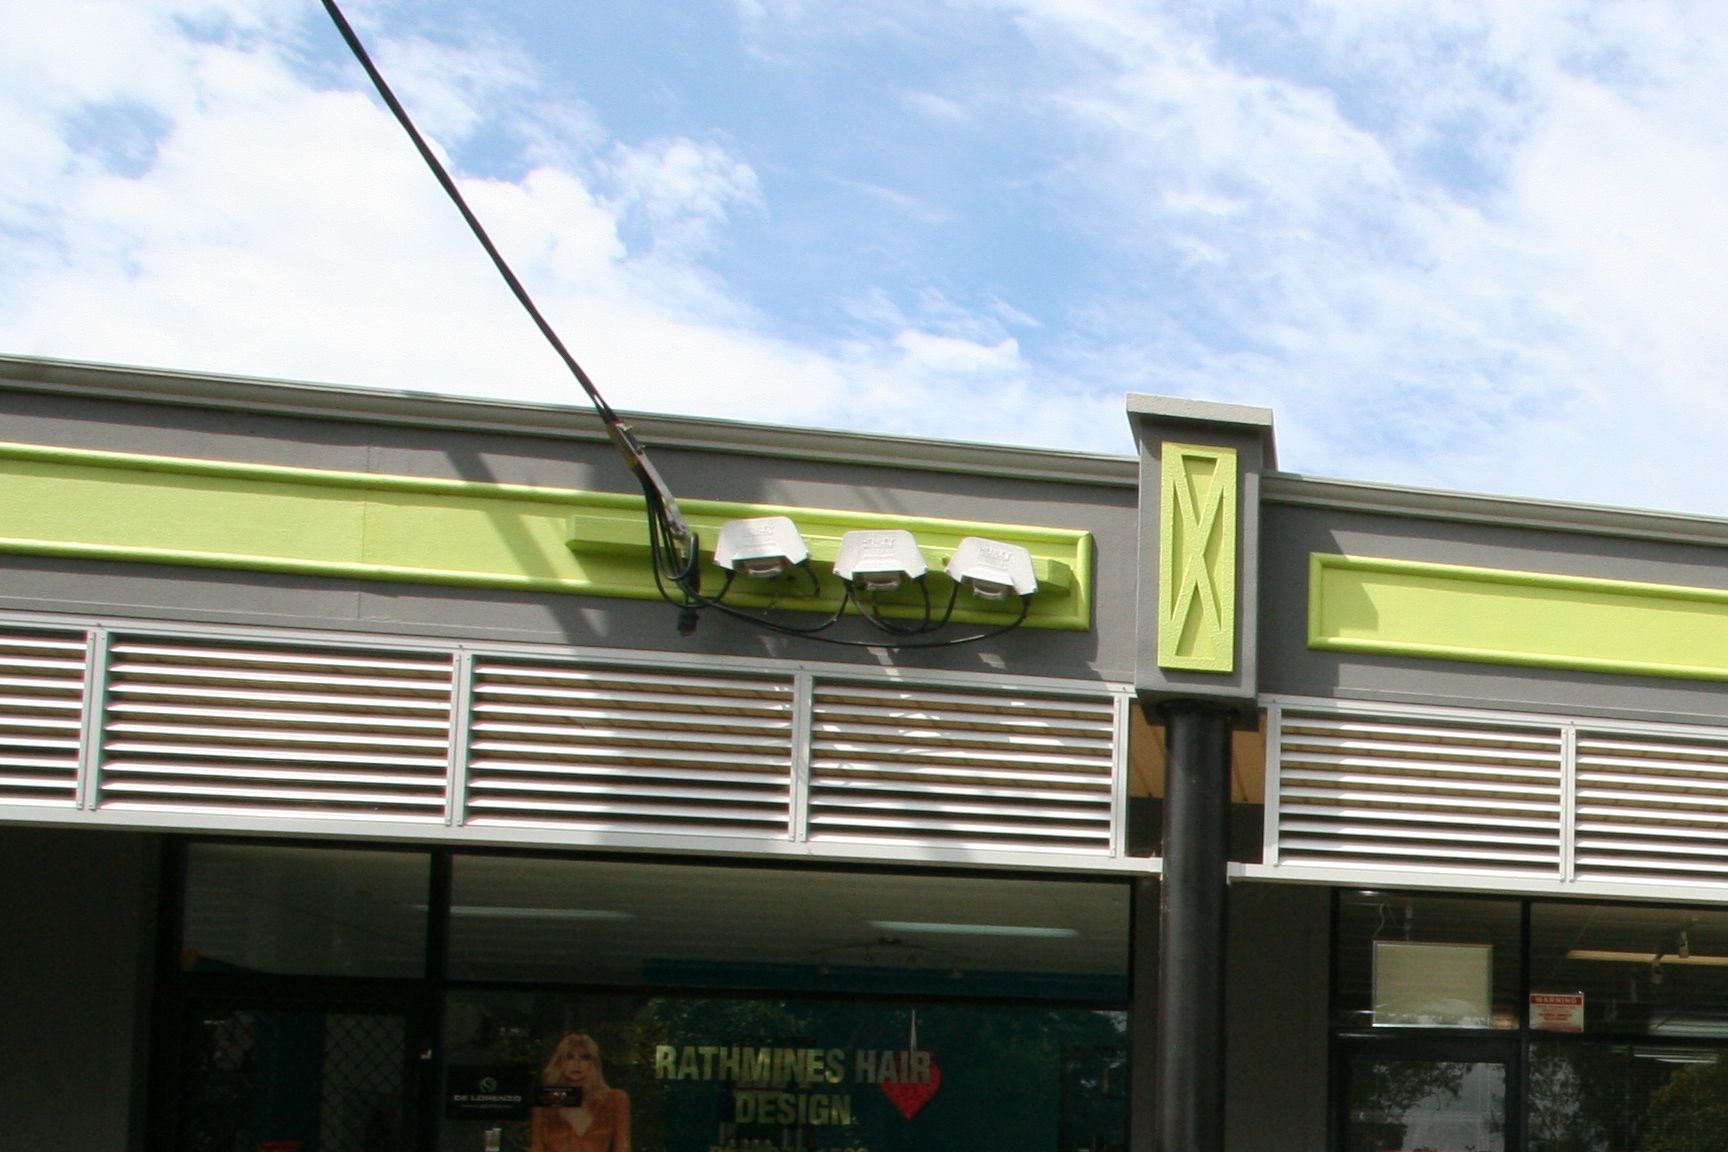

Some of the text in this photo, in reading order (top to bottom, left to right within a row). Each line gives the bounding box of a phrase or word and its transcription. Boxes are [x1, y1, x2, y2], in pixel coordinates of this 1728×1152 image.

[1535, 996, 1577, 1004] WARNING
[655, 1045, 931, 1083] RATHMINES HAIR
[736, 1092, 852, 1125] DESIGN
